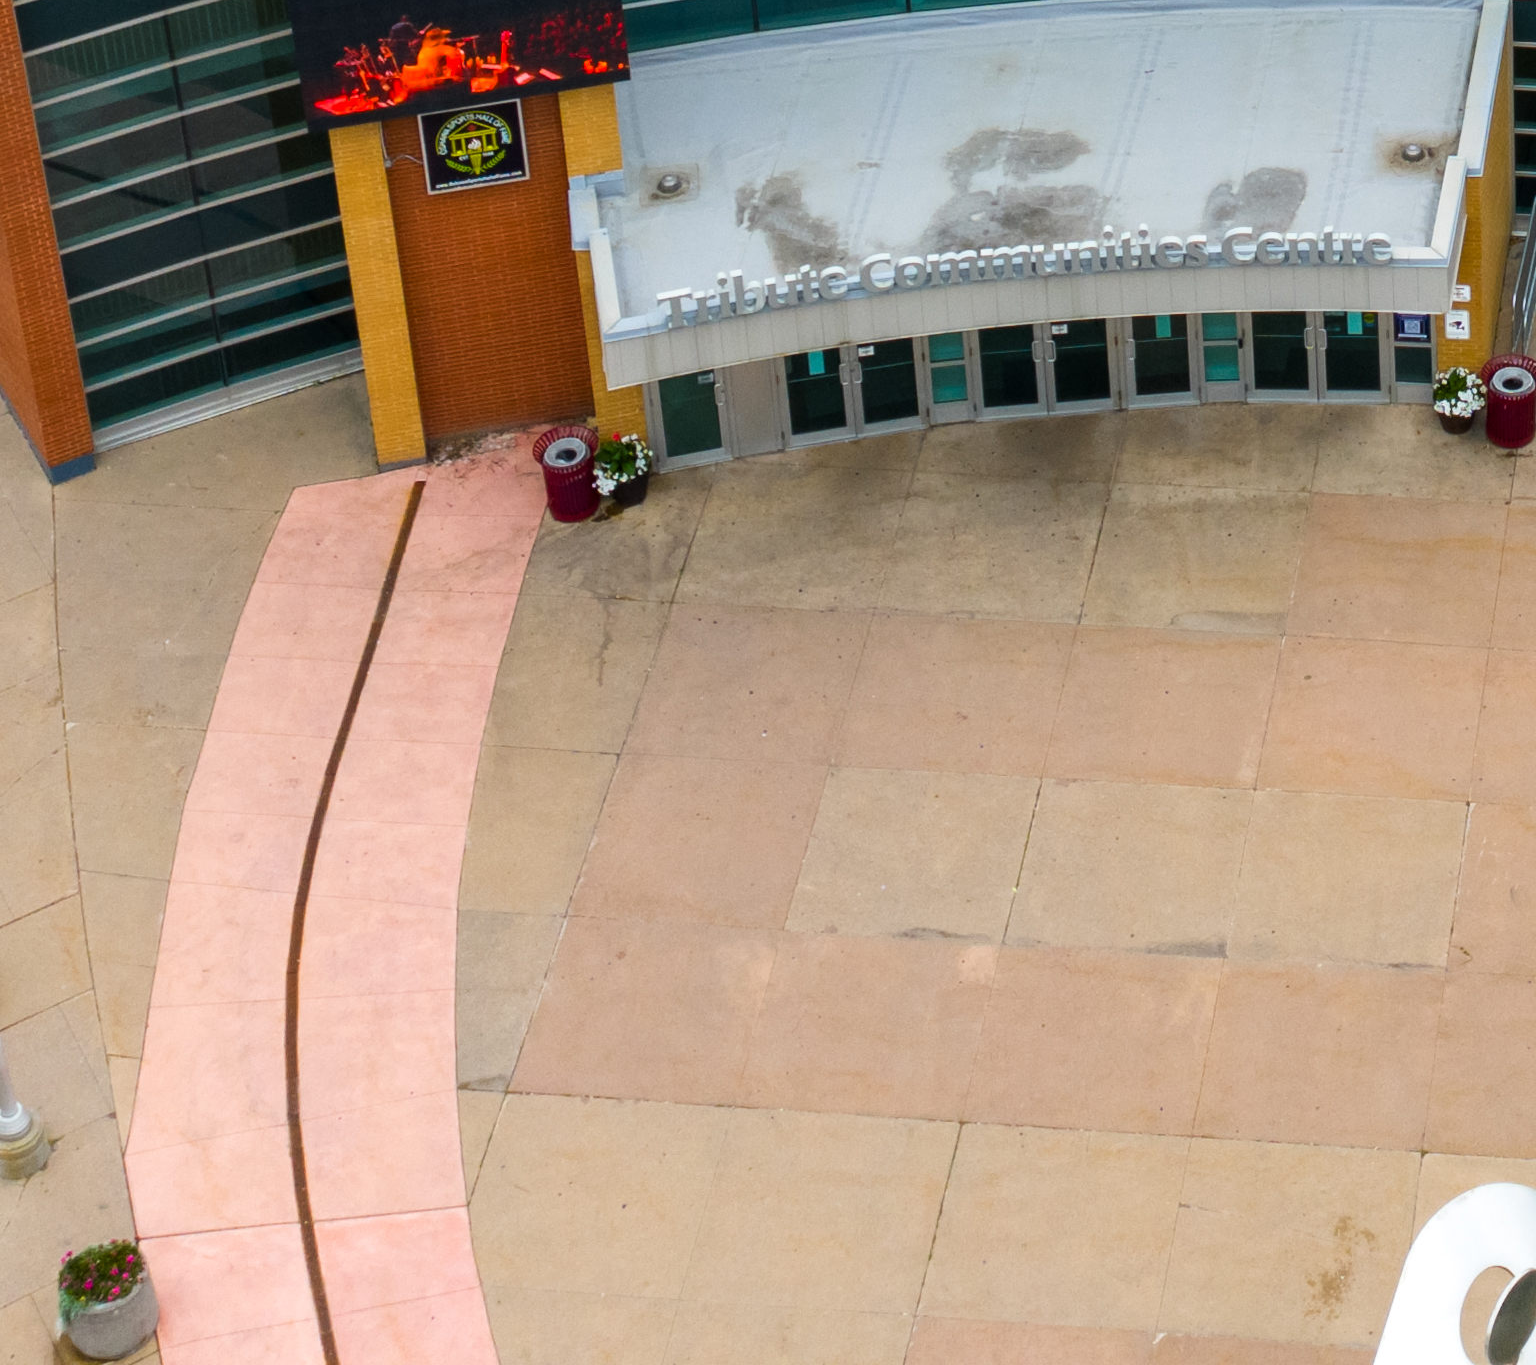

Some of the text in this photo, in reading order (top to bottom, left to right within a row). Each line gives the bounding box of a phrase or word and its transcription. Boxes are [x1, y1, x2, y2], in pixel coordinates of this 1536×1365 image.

[655, 222, 1394, 329] Tribute Communities Centre
